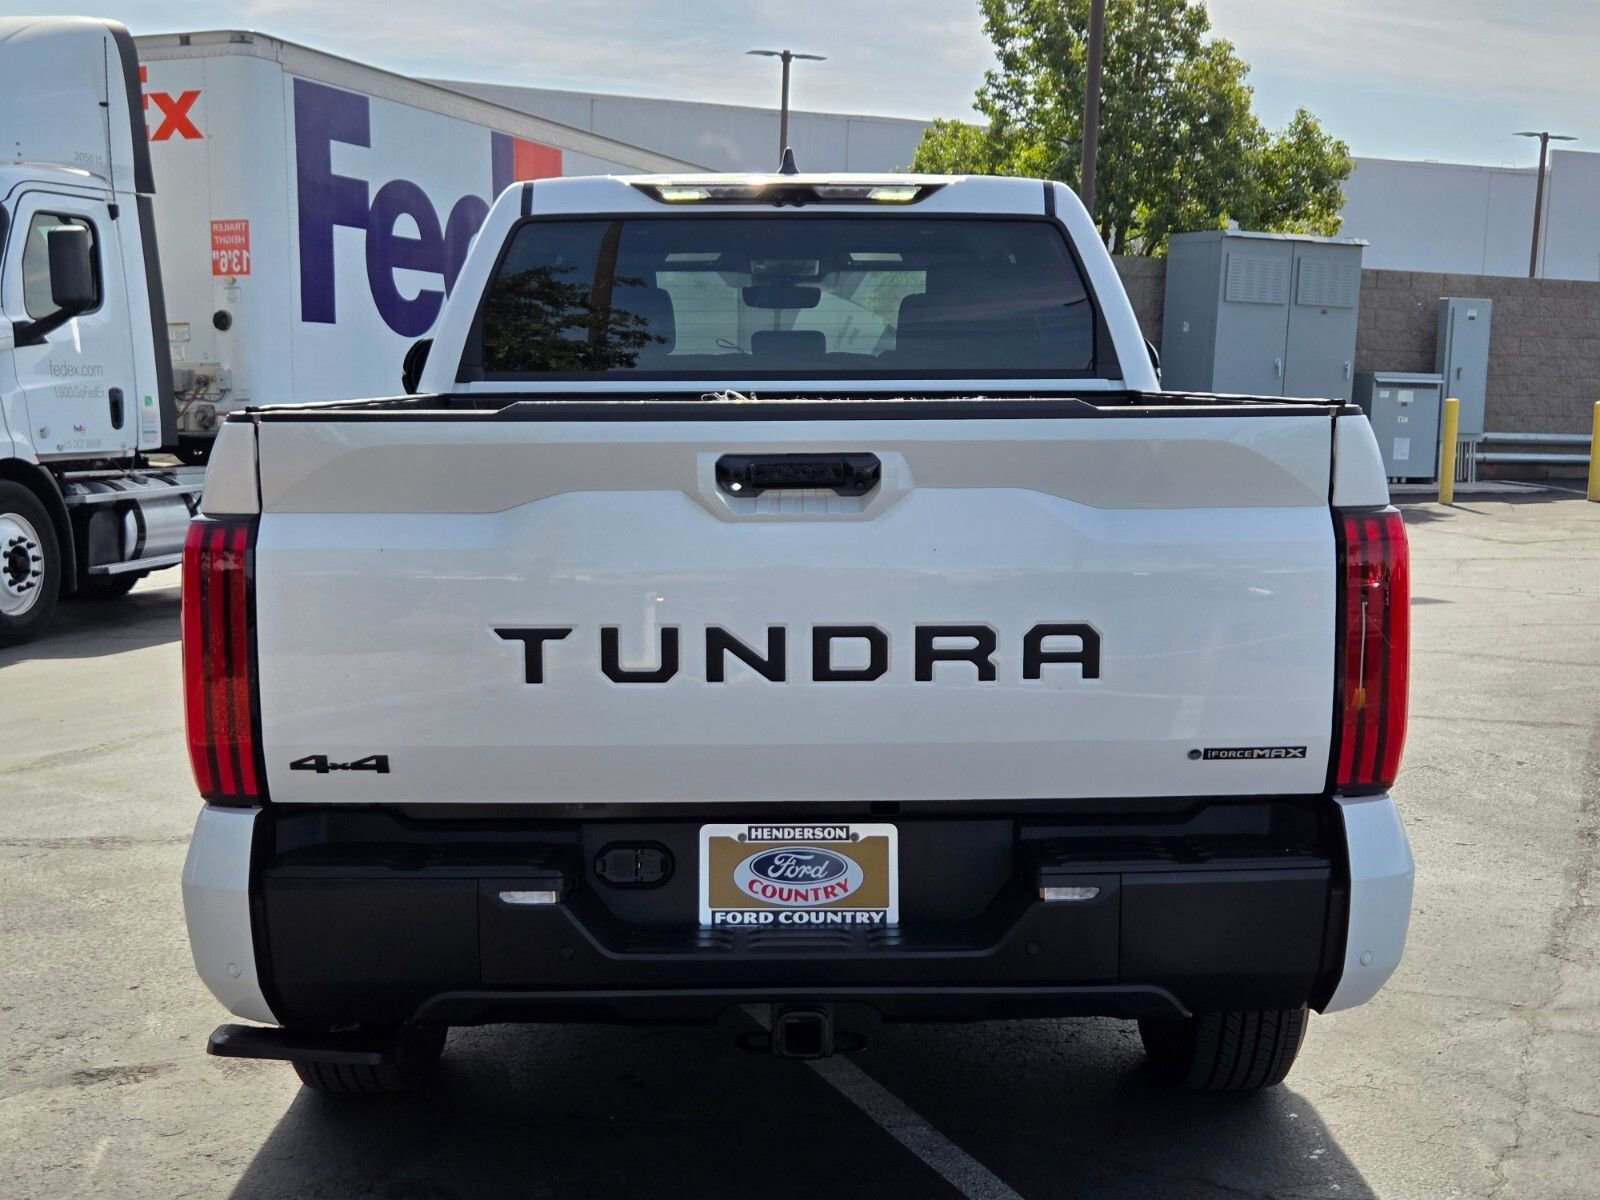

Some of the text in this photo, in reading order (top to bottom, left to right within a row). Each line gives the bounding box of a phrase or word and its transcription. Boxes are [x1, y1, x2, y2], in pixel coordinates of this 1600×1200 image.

[493, 623, 1102, 685] TUNDRA
[750, 827, 848, 840] HENDERSON
[767, 853, 831, 879] Ford
[747, 878, 850, 903] COUNTRY
[714, 911, 886, 925] FORD COUNTRY
